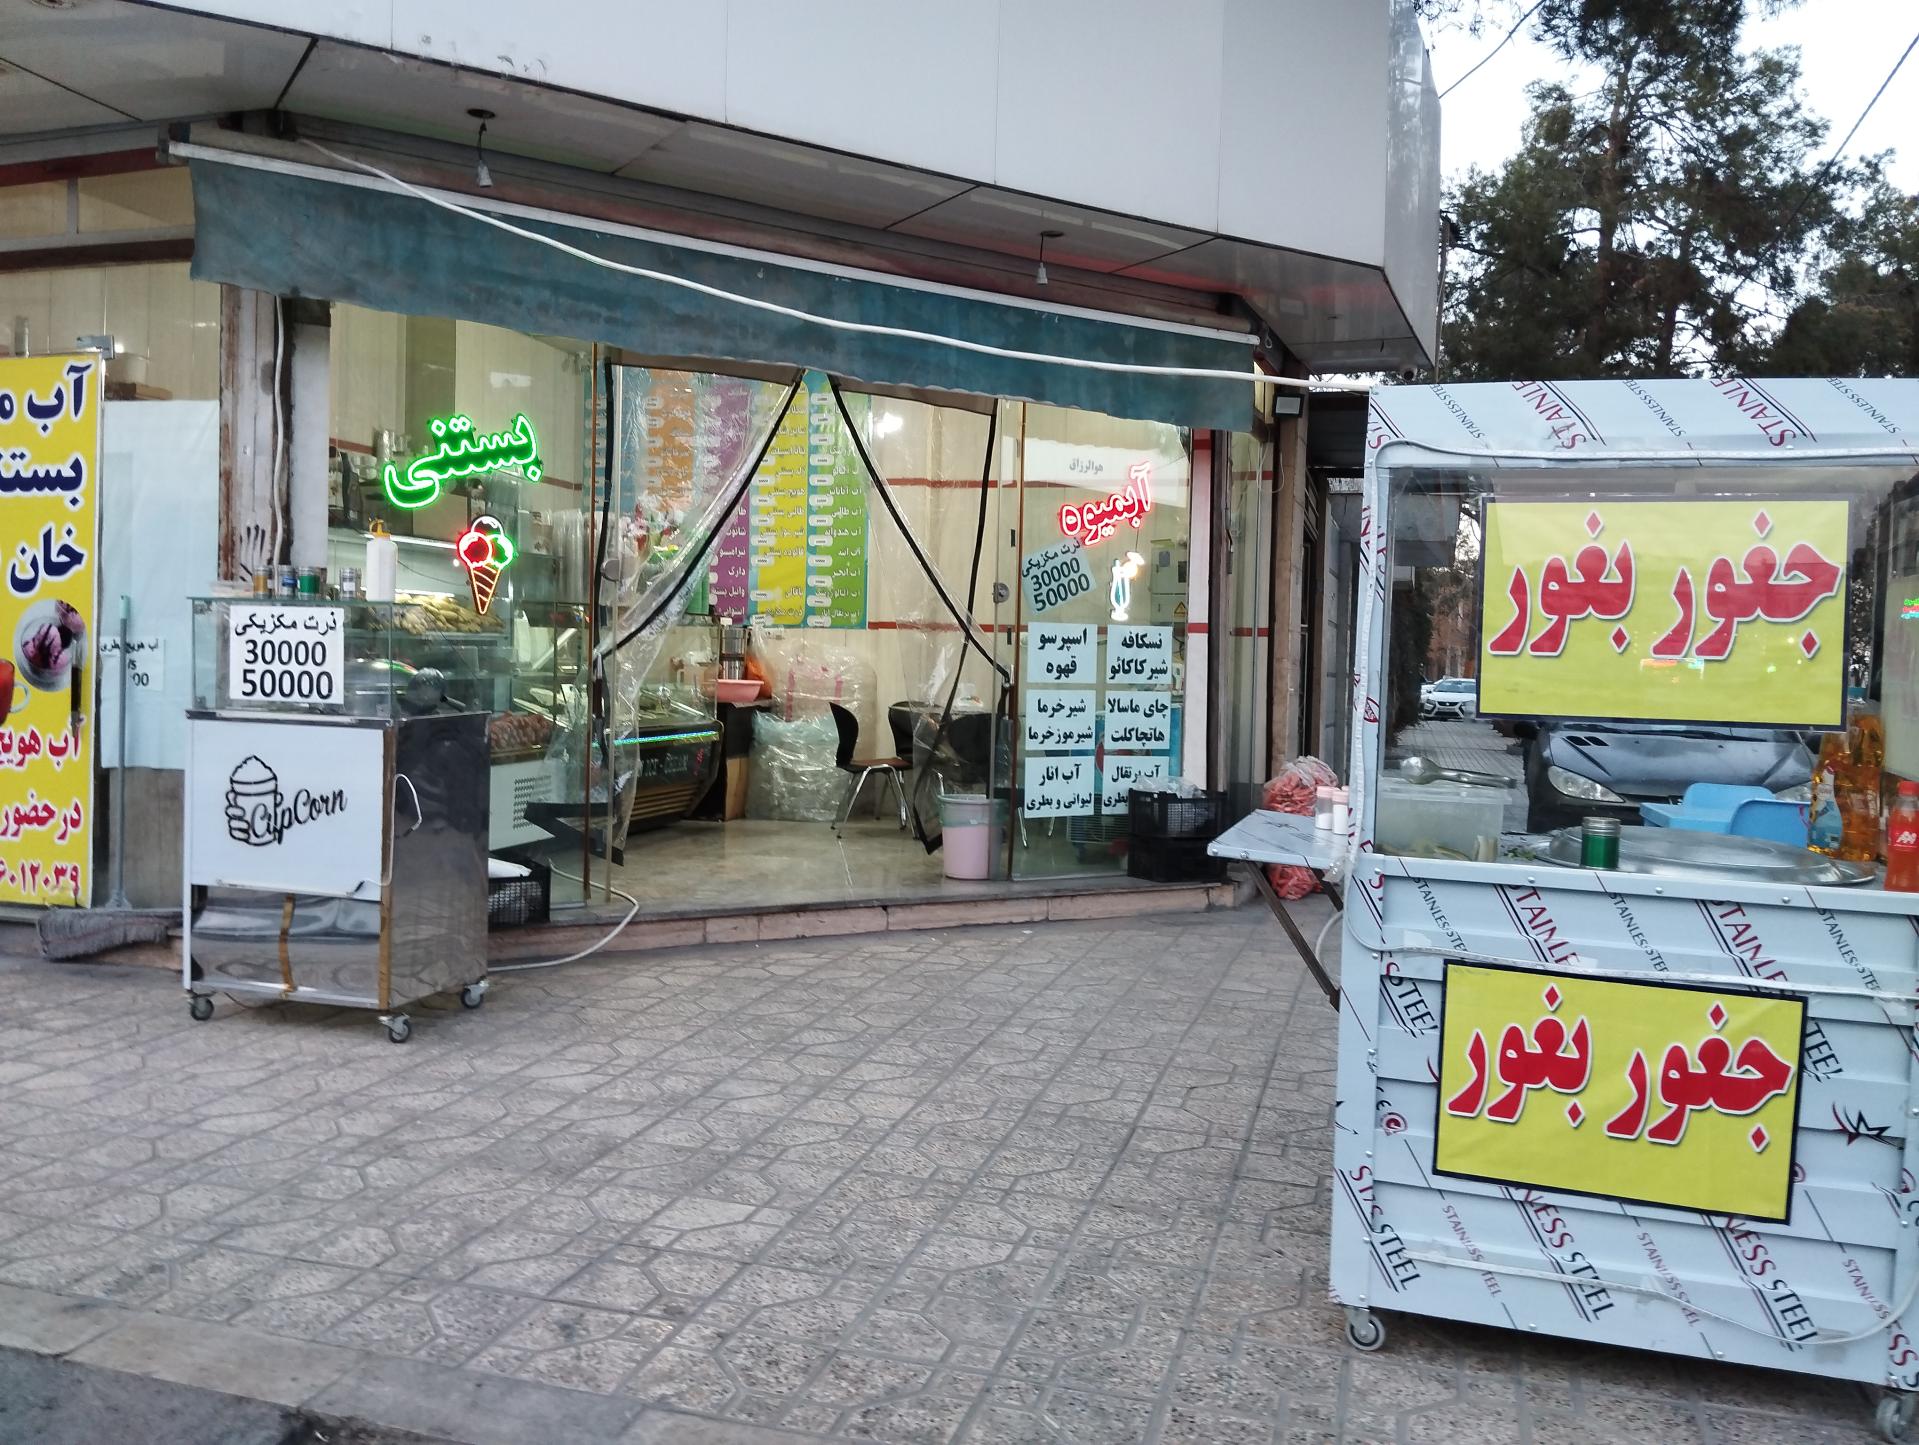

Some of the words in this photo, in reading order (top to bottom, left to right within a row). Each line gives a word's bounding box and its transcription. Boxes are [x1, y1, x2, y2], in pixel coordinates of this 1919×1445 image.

[27, 364, 92, 433] آب
[383, 413, 543, 508] بستنی
[0, 446, 83, 506] بست
[1060, 462, 1153, 546] آبمیوه
[1060, 537, 1081, 554] ذرت
[9, 527, 84, 593] خان
[1022, 551, 1058, 578] مکزیکی
[1030, 557, 1080, 592] 30000
[1487, 509, 1636, 658] بغور
[1650, 508, 1844, 662] جغور
[1033, 573, 1090, 612] 50000
[234, 613, 298, 636] مکزیکی
[303, 611, 337, 636] ذرت
[245, 639, 327, 667] 30000
[1037, 627, 1088, 652] اسپرسو
[1121, 631, 1163, 649] نسکافه
[1046, 655, 1077, 680] قهوه
[242, 669, 333, 699] 50000
[1107, 697, 1140, 713] ماسالا
[1143, 698, 1169, 719] چای
[1038, 766, 1059, 786] انار
[1061, 763, 1082, 785] آب
[1026, 794, 1053, 811] بطری
[1055, 799, 1061, 809] و
[1063, 792, 1093, 809] لیوانی
[1412, 877, 1450, 931] STAINLES
[1818, 908, 1859, 966] STAINLES
[1445, 982, 1594, 1128] بغور
[1603, 1001, 1796, 1154] جغور
